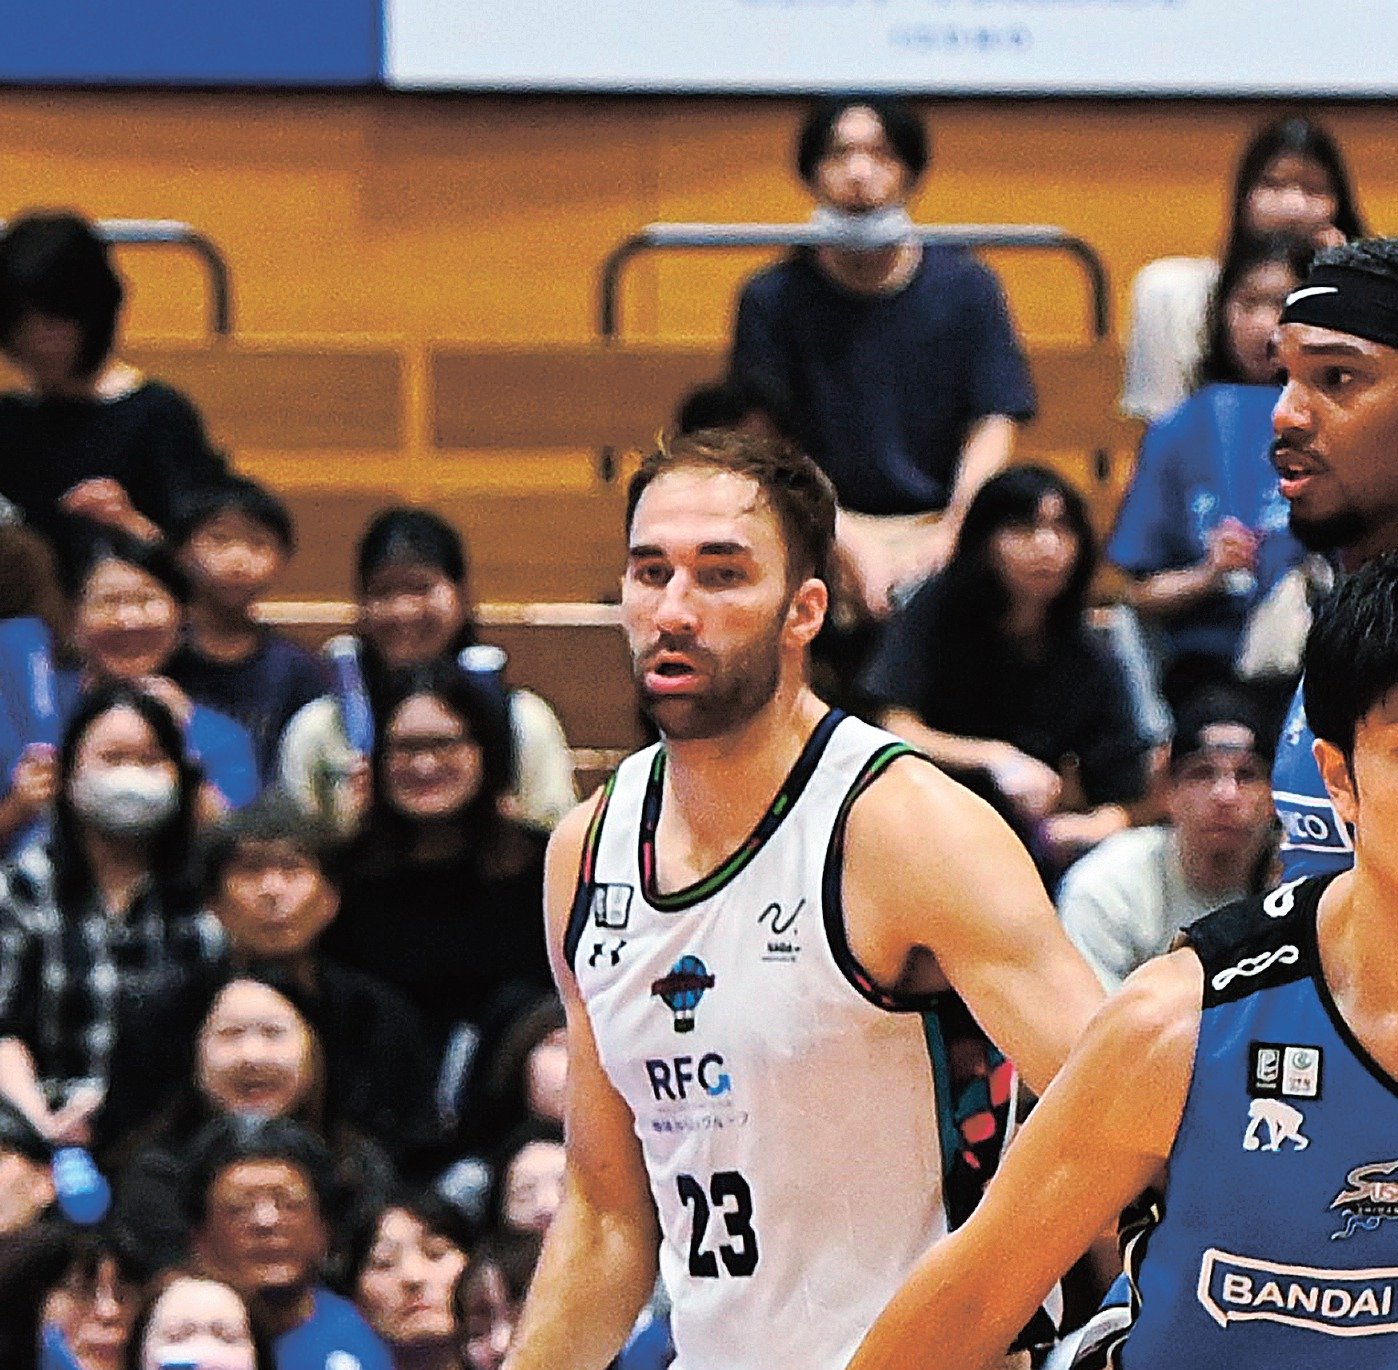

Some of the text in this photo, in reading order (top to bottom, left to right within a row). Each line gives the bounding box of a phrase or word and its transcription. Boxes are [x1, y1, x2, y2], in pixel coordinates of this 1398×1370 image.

[645, 1053, 731, 1100] RFG
[676, 1171, 759, 1278] 23
[1222, 1273, 1392, 1319] BANDAI
